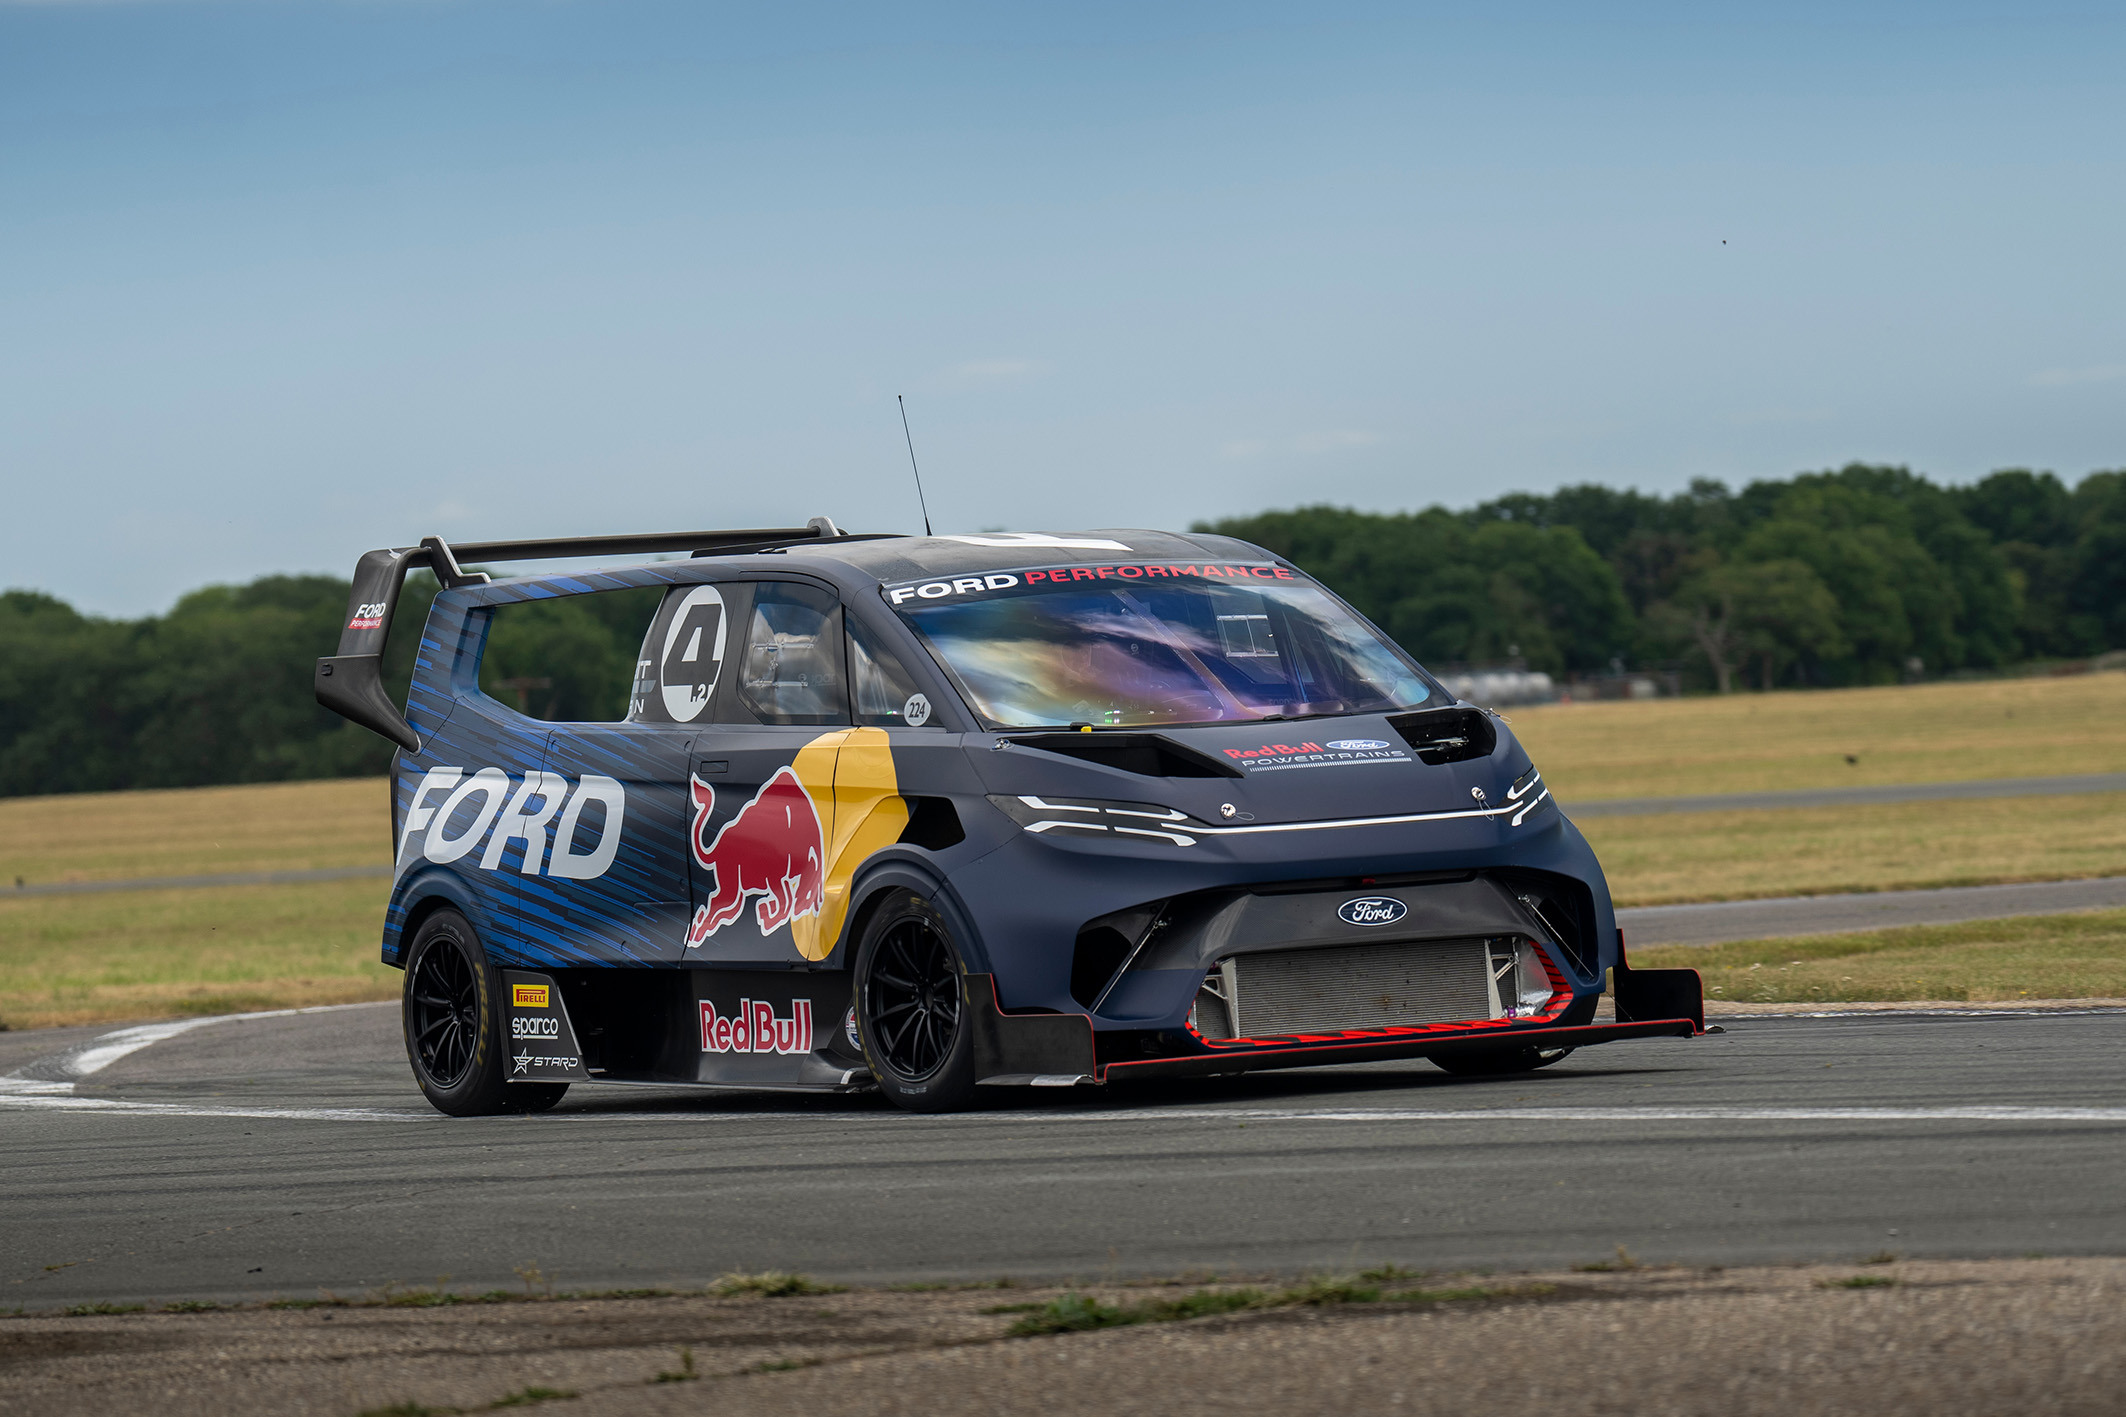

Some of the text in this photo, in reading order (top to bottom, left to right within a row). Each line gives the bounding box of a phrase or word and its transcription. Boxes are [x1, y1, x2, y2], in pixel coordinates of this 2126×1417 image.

[889, 565, 1295, 605] FORD PERFORMANCE
[354, 602, 387, 619] FORD
[908, 701, 926, 719] 224
[1222, 745, 1275, 760] Red
[1272, 741, 1325, 756] Bull
[1242, 750, 1405, 767] POWERTRAINS
[396, 766, 625, 880] FORD
[1352, 900, 1394, 921] Ford
[516, 988, 546, 1003] PIRELLI
[511, 1017, 559, 1040] sparco
[698, 997, 751, 1054] Red
[752, 998, 813, 1056] Bull
[533, 1056, 579, 1071] STARD
